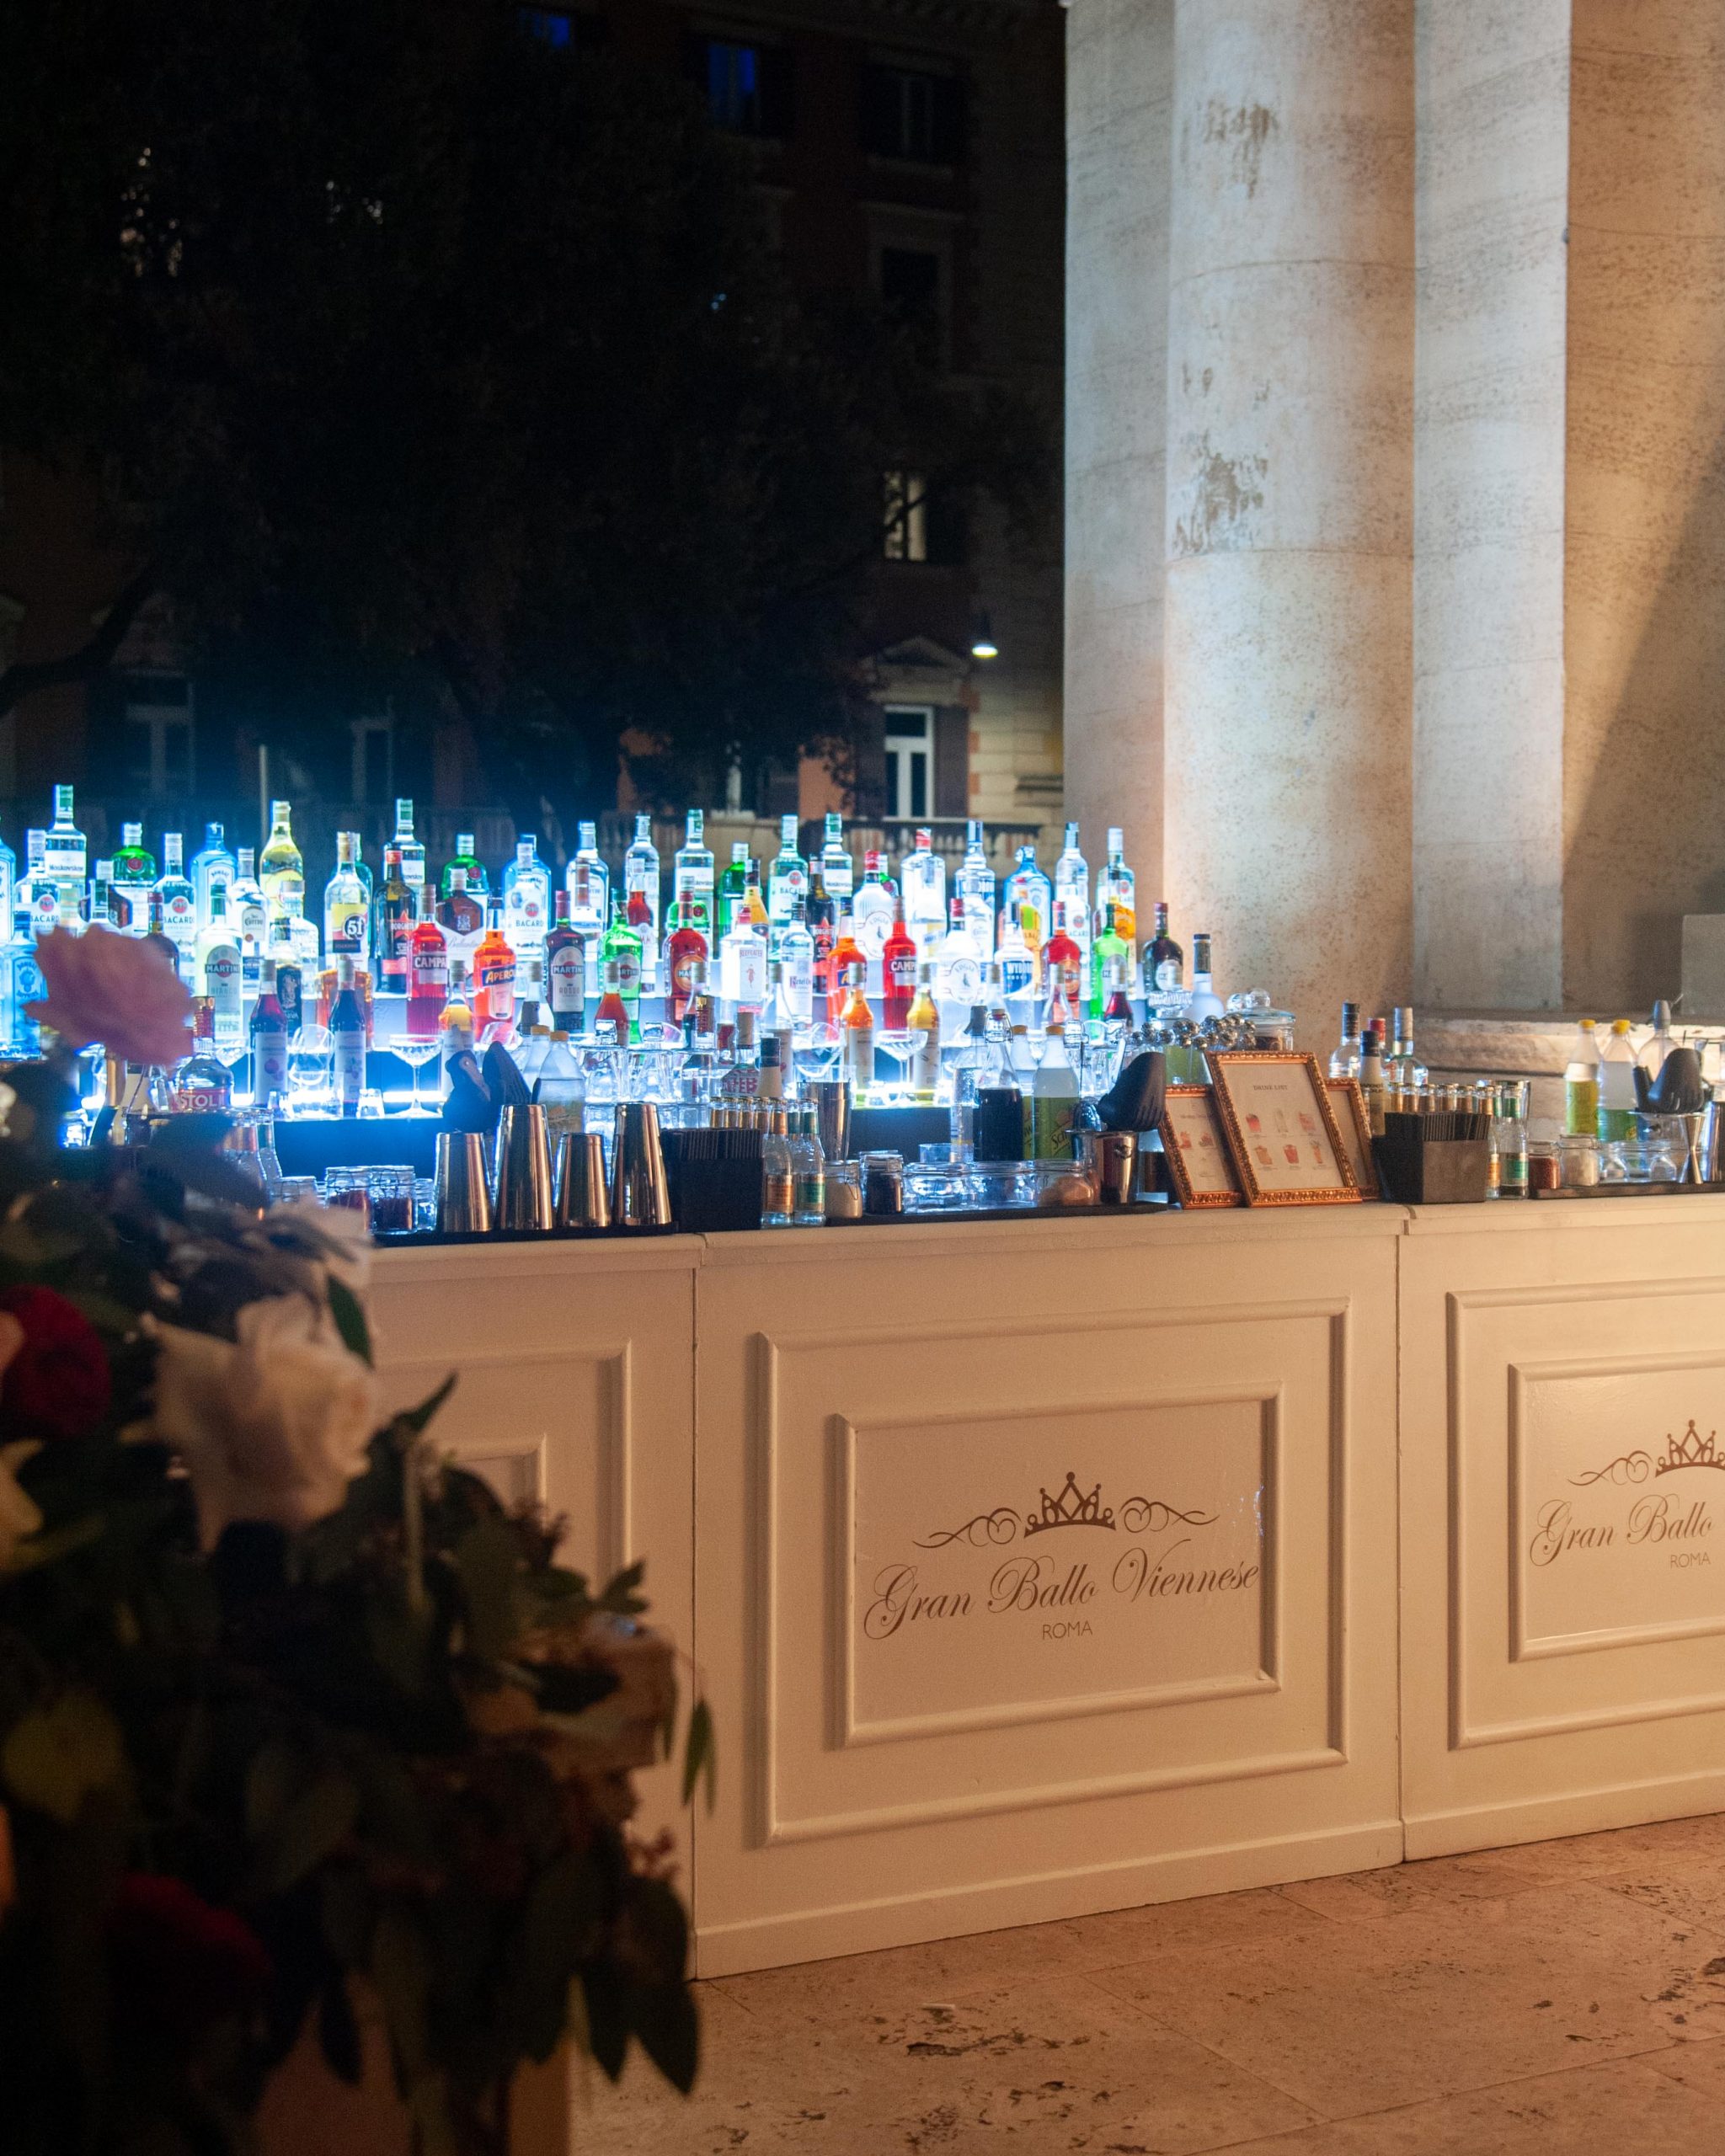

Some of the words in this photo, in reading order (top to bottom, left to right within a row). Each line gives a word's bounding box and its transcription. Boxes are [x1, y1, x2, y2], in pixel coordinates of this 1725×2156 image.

[347, 920, 363, 936] 51
[414, 956, 446, 969] CAMPA
[890, 958, 916, 971] CAMP
[485, 969, 514, 984] APERO
[1530, 1498, 1615, 1567] Gran
[1626, 1492, 1713, 1545] Ballo
[1669, 1551, 1712, 1569] ROMA
[863, 1563, 976, 1641] Gran
[987, 1555, 1100, 1614] Ballo
[1111, 1538, 1260, 1603] Viennese
[1041, 1620, 1093, 1641] ROMA
